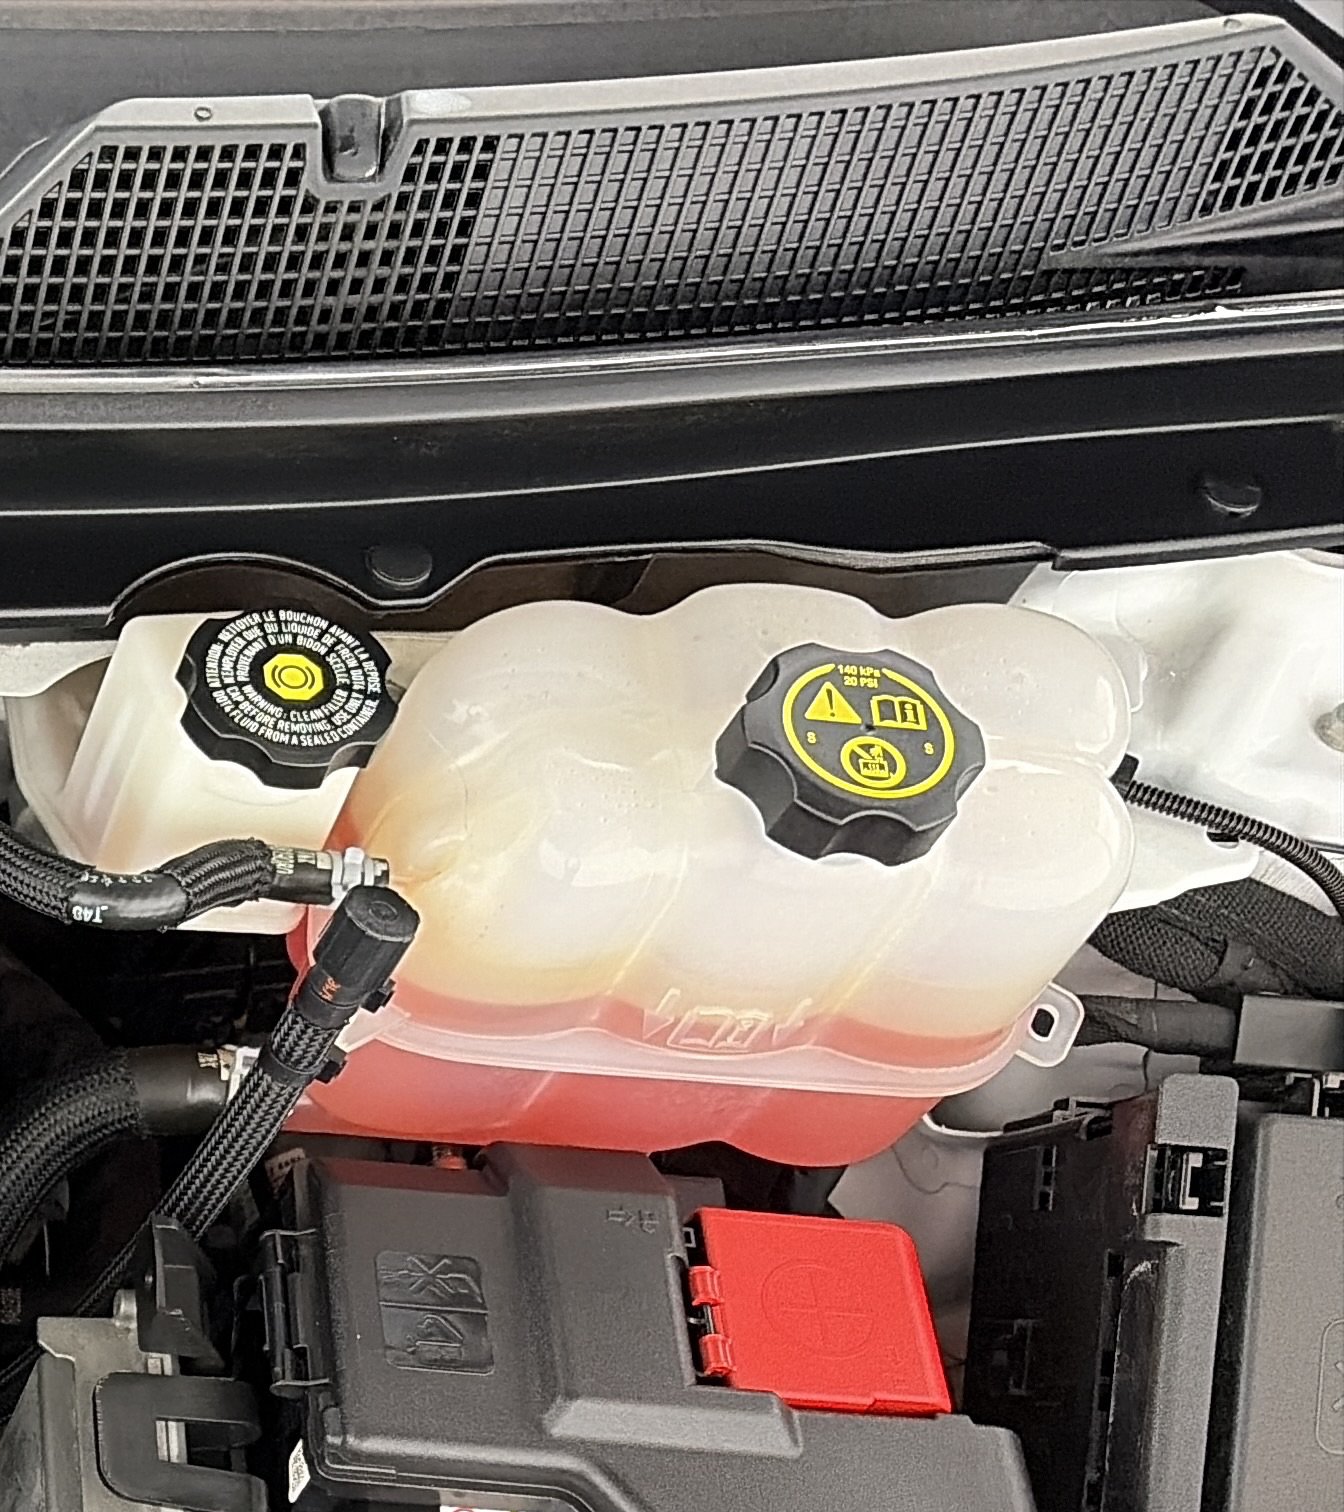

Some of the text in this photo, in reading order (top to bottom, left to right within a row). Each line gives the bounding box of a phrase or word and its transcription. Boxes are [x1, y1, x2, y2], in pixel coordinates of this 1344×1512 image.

[242, 626, 264, 641] QUE
[264, 622, 278, 633] DU
[282, 622, 321, 639] LIQUIDE
[321, 633, 337, 647] DE
[334, 644, 359, 668] FREIN
[262, 610, 276, 621] LE
[279, 610, 329, 630] BOUCHON
[328, 624, 360, 648] AVANT
[354, 647, 370, 660] LA
[267, 634, 292, 645] D'UN
[296, 635, 328, 655] BIDON
[837, 664, 880, 678] 140 kPa
[844, 676, 878, 688] 20 PSI
[226, 686, 245, 702] CAP
[238, 700, 277, 728] BEFORE
[331, 709, 352, 725] USE
[344, 692, 364, 714] ONLY
[290, 708, 325, 722] CLEAN
[321, 688, 348, 716] FILLER
[229, 709, 259, 732] FLUID
[258, 726, 289, 744] FROM
[291, 735, 298, 745] A
[300, 730, 340, 746] SEALED
